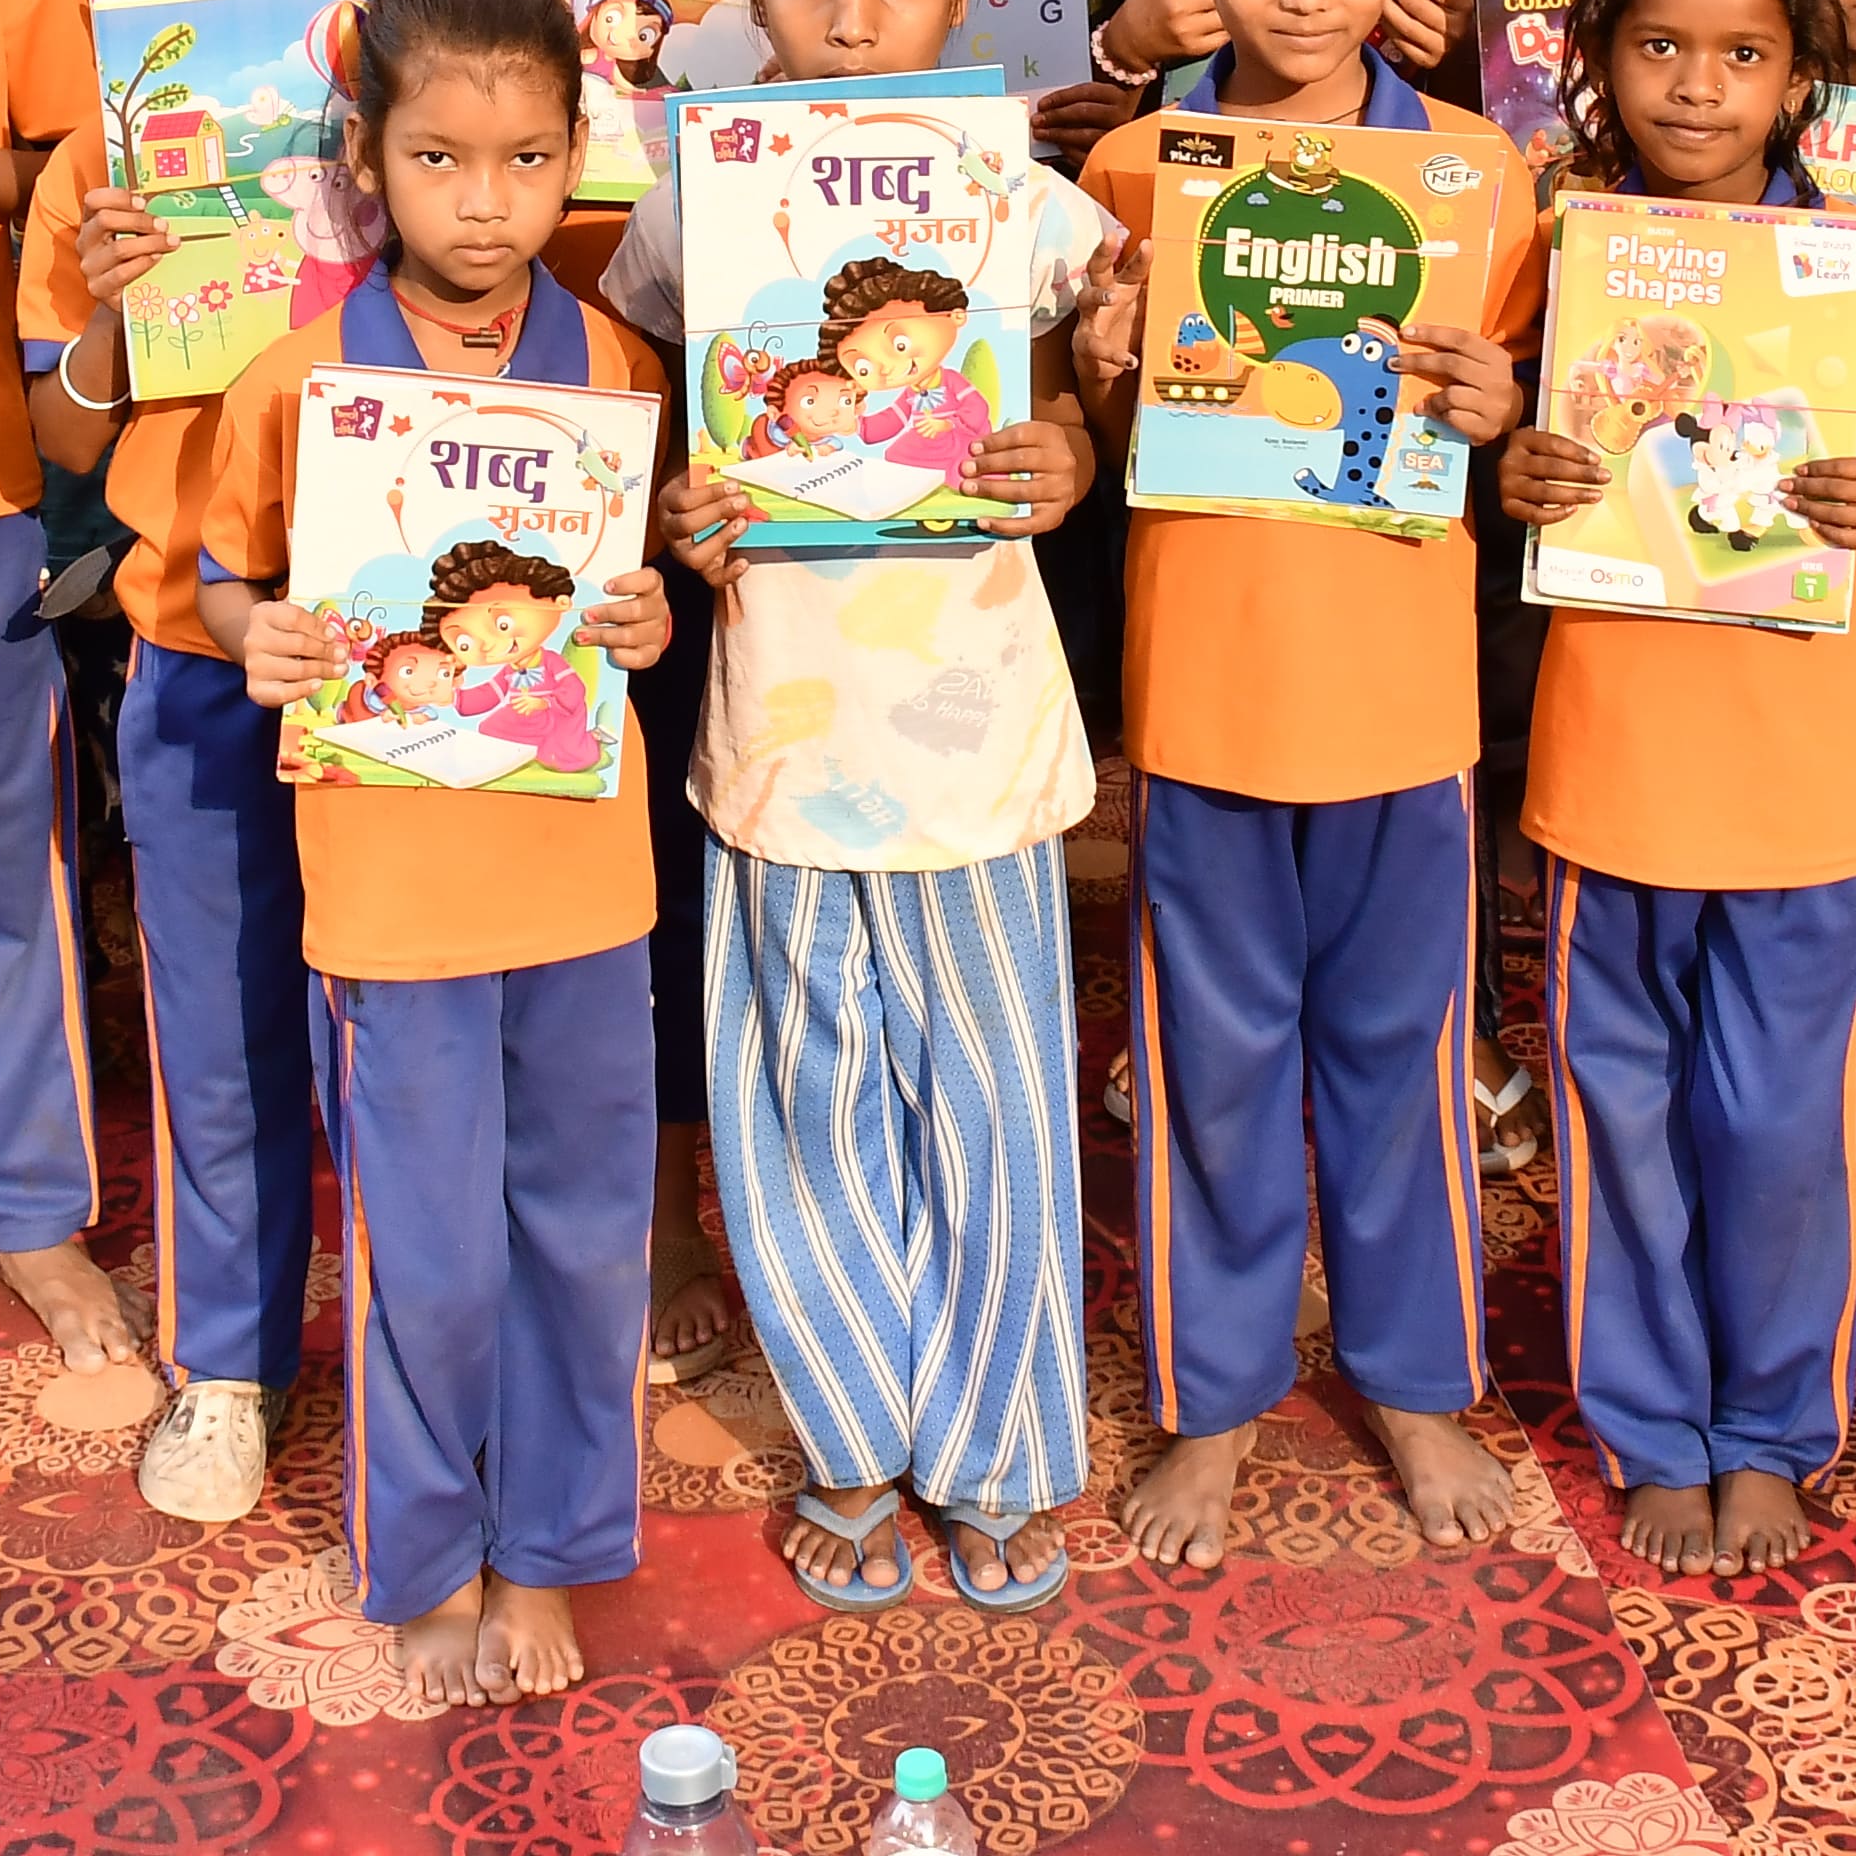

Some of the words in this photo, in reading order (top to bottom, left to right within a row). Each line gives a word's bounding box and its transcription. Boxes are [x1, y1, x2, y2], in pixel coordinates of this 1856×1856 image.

[812, 155, 936, 216] शब्द
[1431, 170, 1482, 186] NEP
[874, 218, 980, 258] सृजन
[1223, 227, 1397, 287] English
[1607, 235, 1728, 279] Playing
[1605, 268, 1722, 310] Shapes
[1667, 266, 1702, 283] With
[1816, 269, 1851, 281] Learn
[1269, 287, 1345, 310] PRIMER
[430, 440, 554, 504] शब्द
[1404, 452, 1445, 471] SEA
[486, 504, 594, 543] सृजन
[1590, 568, 1644, 587] Osmo
